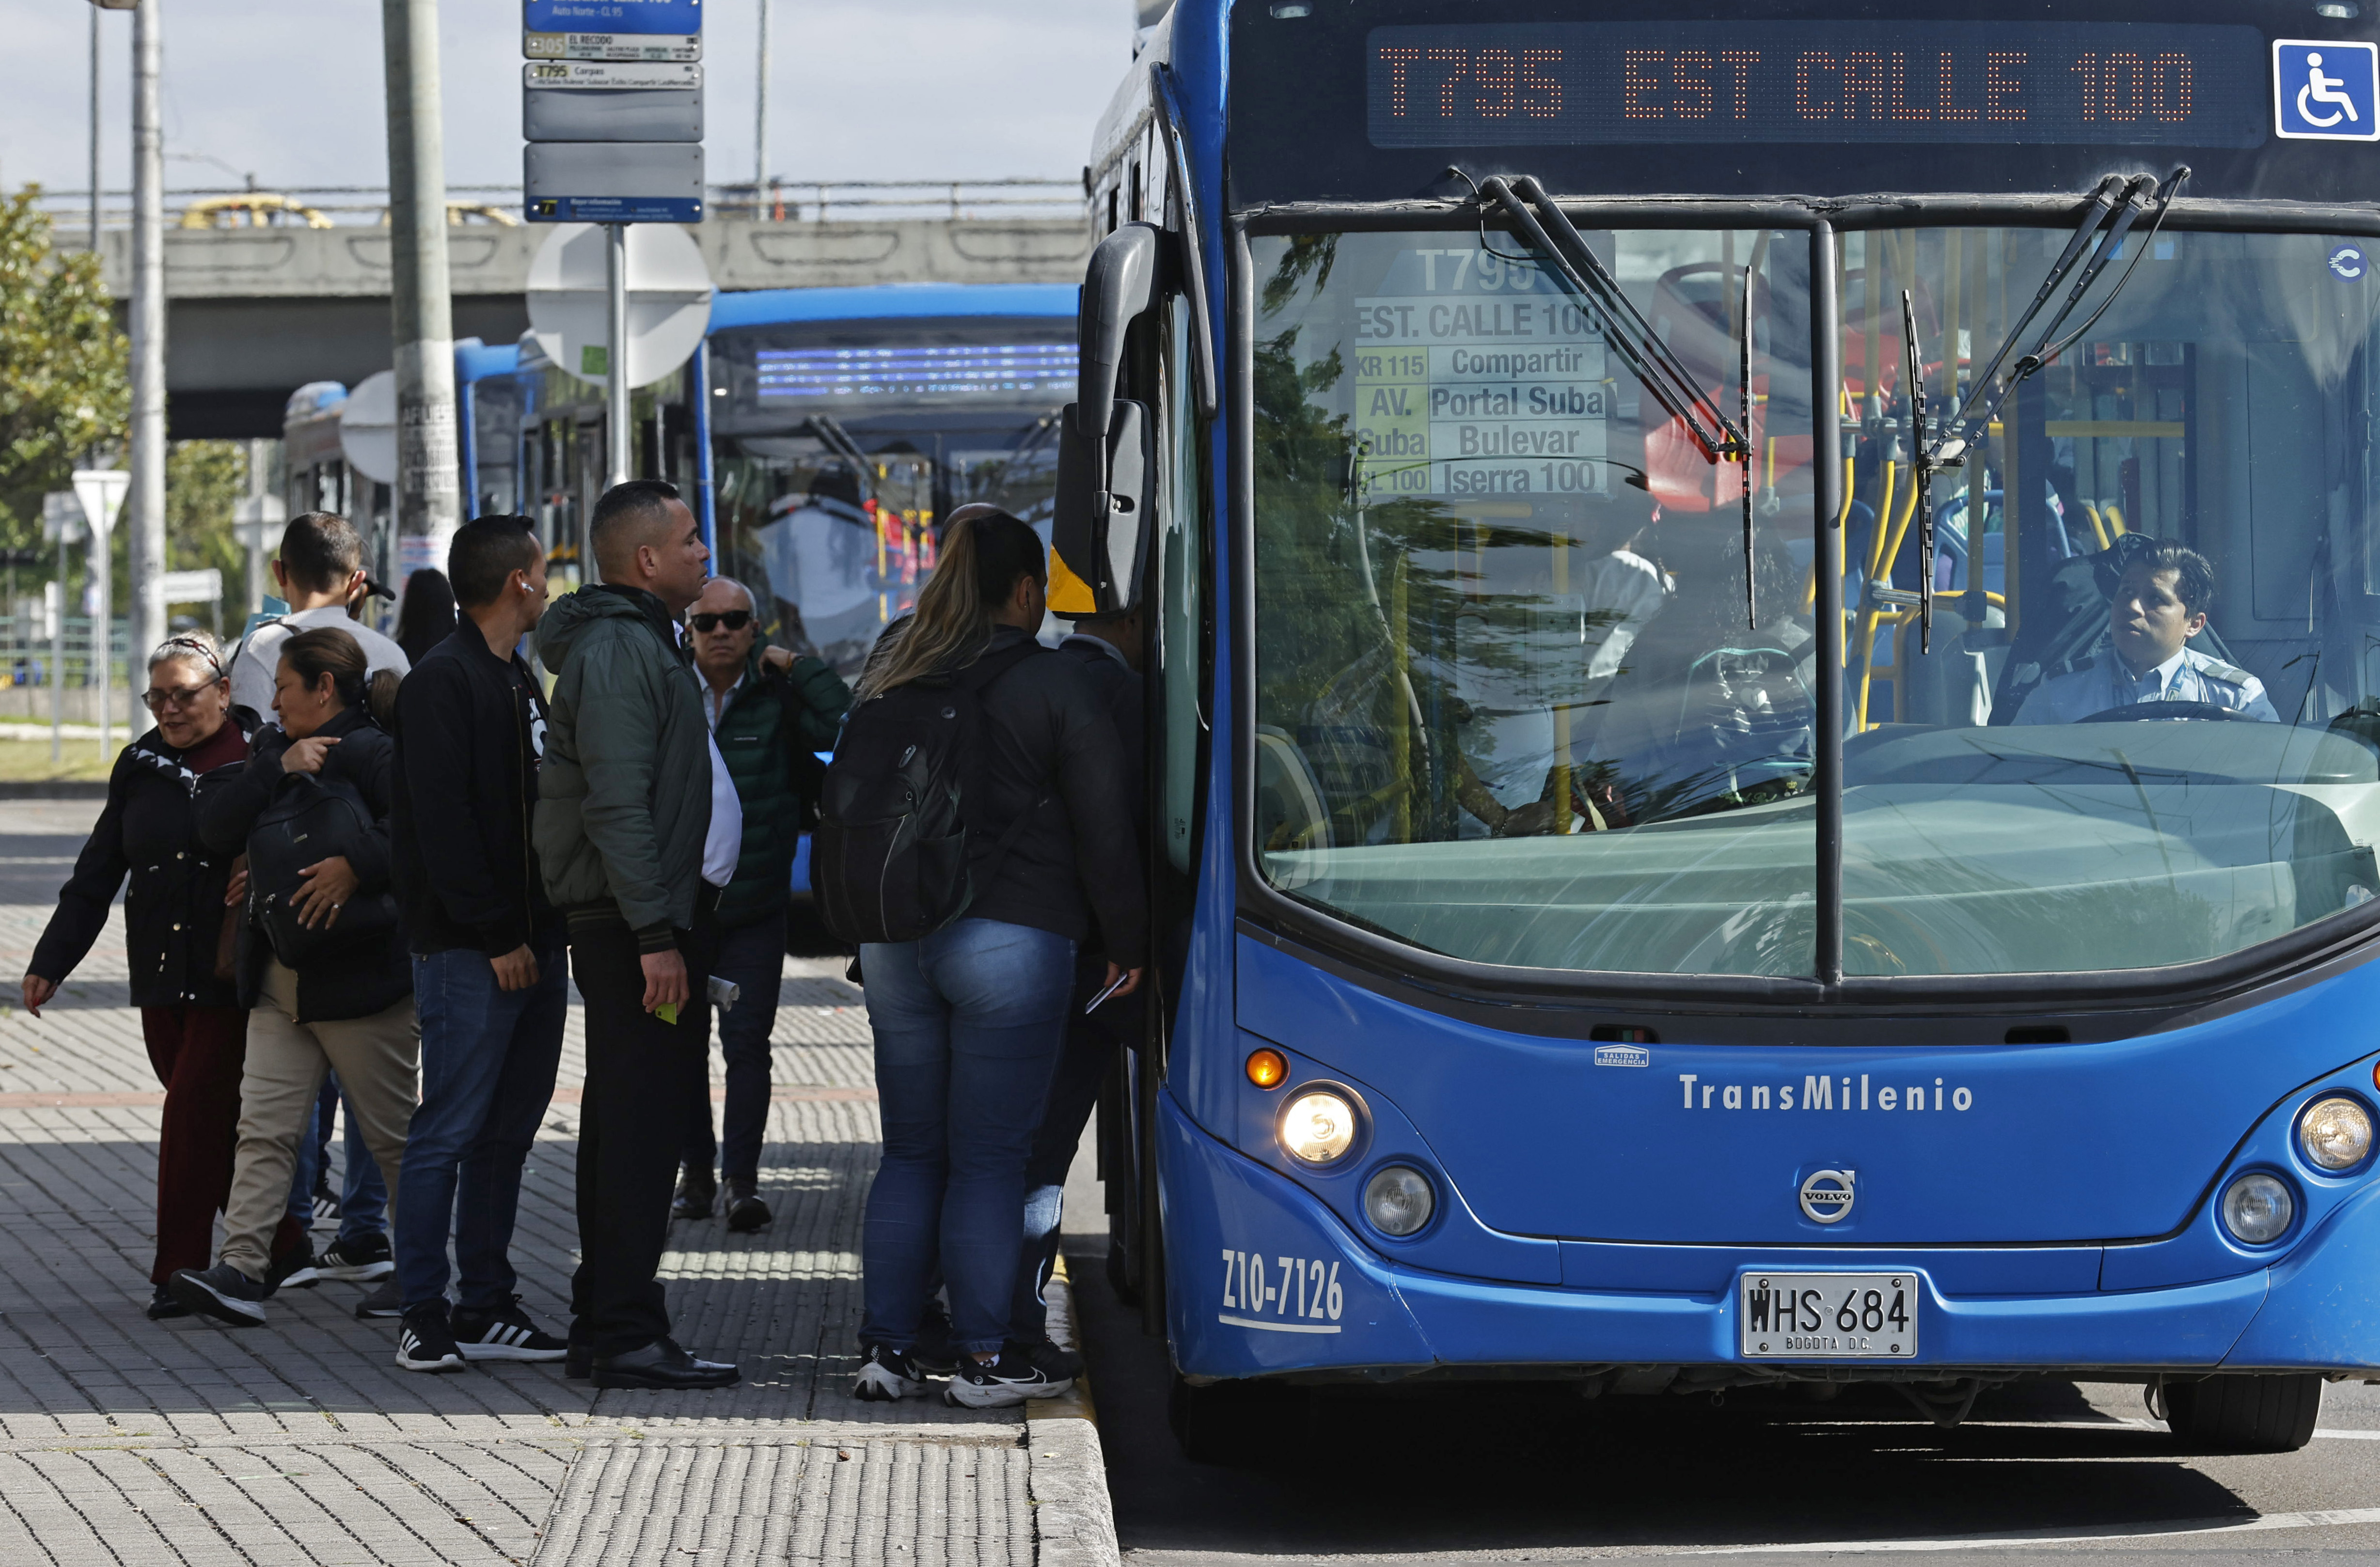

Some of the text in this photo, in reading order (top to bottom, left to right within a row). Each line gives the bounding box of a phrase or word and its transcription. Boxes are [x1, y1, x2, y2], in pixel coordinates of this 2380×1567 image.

[552, 5, 570, 16] Auto
[572, 6, 595, 16] Norte
[537, 65, 567, 77] T795
[1380, 48, 2192, 122] T795 EST CALLE 100
[1416, 249, 1535, 291] T795
[1355, 303, 1602, 339] EST. CALLE 100
[1355, 355, 1424, 377] KR 115
[1452, 347, 1583, 379] Compartir
[1370, 388, 1412, 416] AV.
[1432, 386, 1603, 416] Portal Suba
[1357, 427, 1426, 456] Suba
[1459, 424, 1580, 455] Bulevar
[1389, 470, 1426, 491] 100
[1444, 462, 1596, 493] Iserra 100
[1679, 1074, 1973, 1111] TransMilenio
[1803, 1192, 1851, 1201] VOLVO
[1222, 1249, 1343, 1320] Z10-7126
[1750, 1288, 1909, 1332] WHS 684
[1786, 1336, 1873, 1349] BOGOTA D.C.
